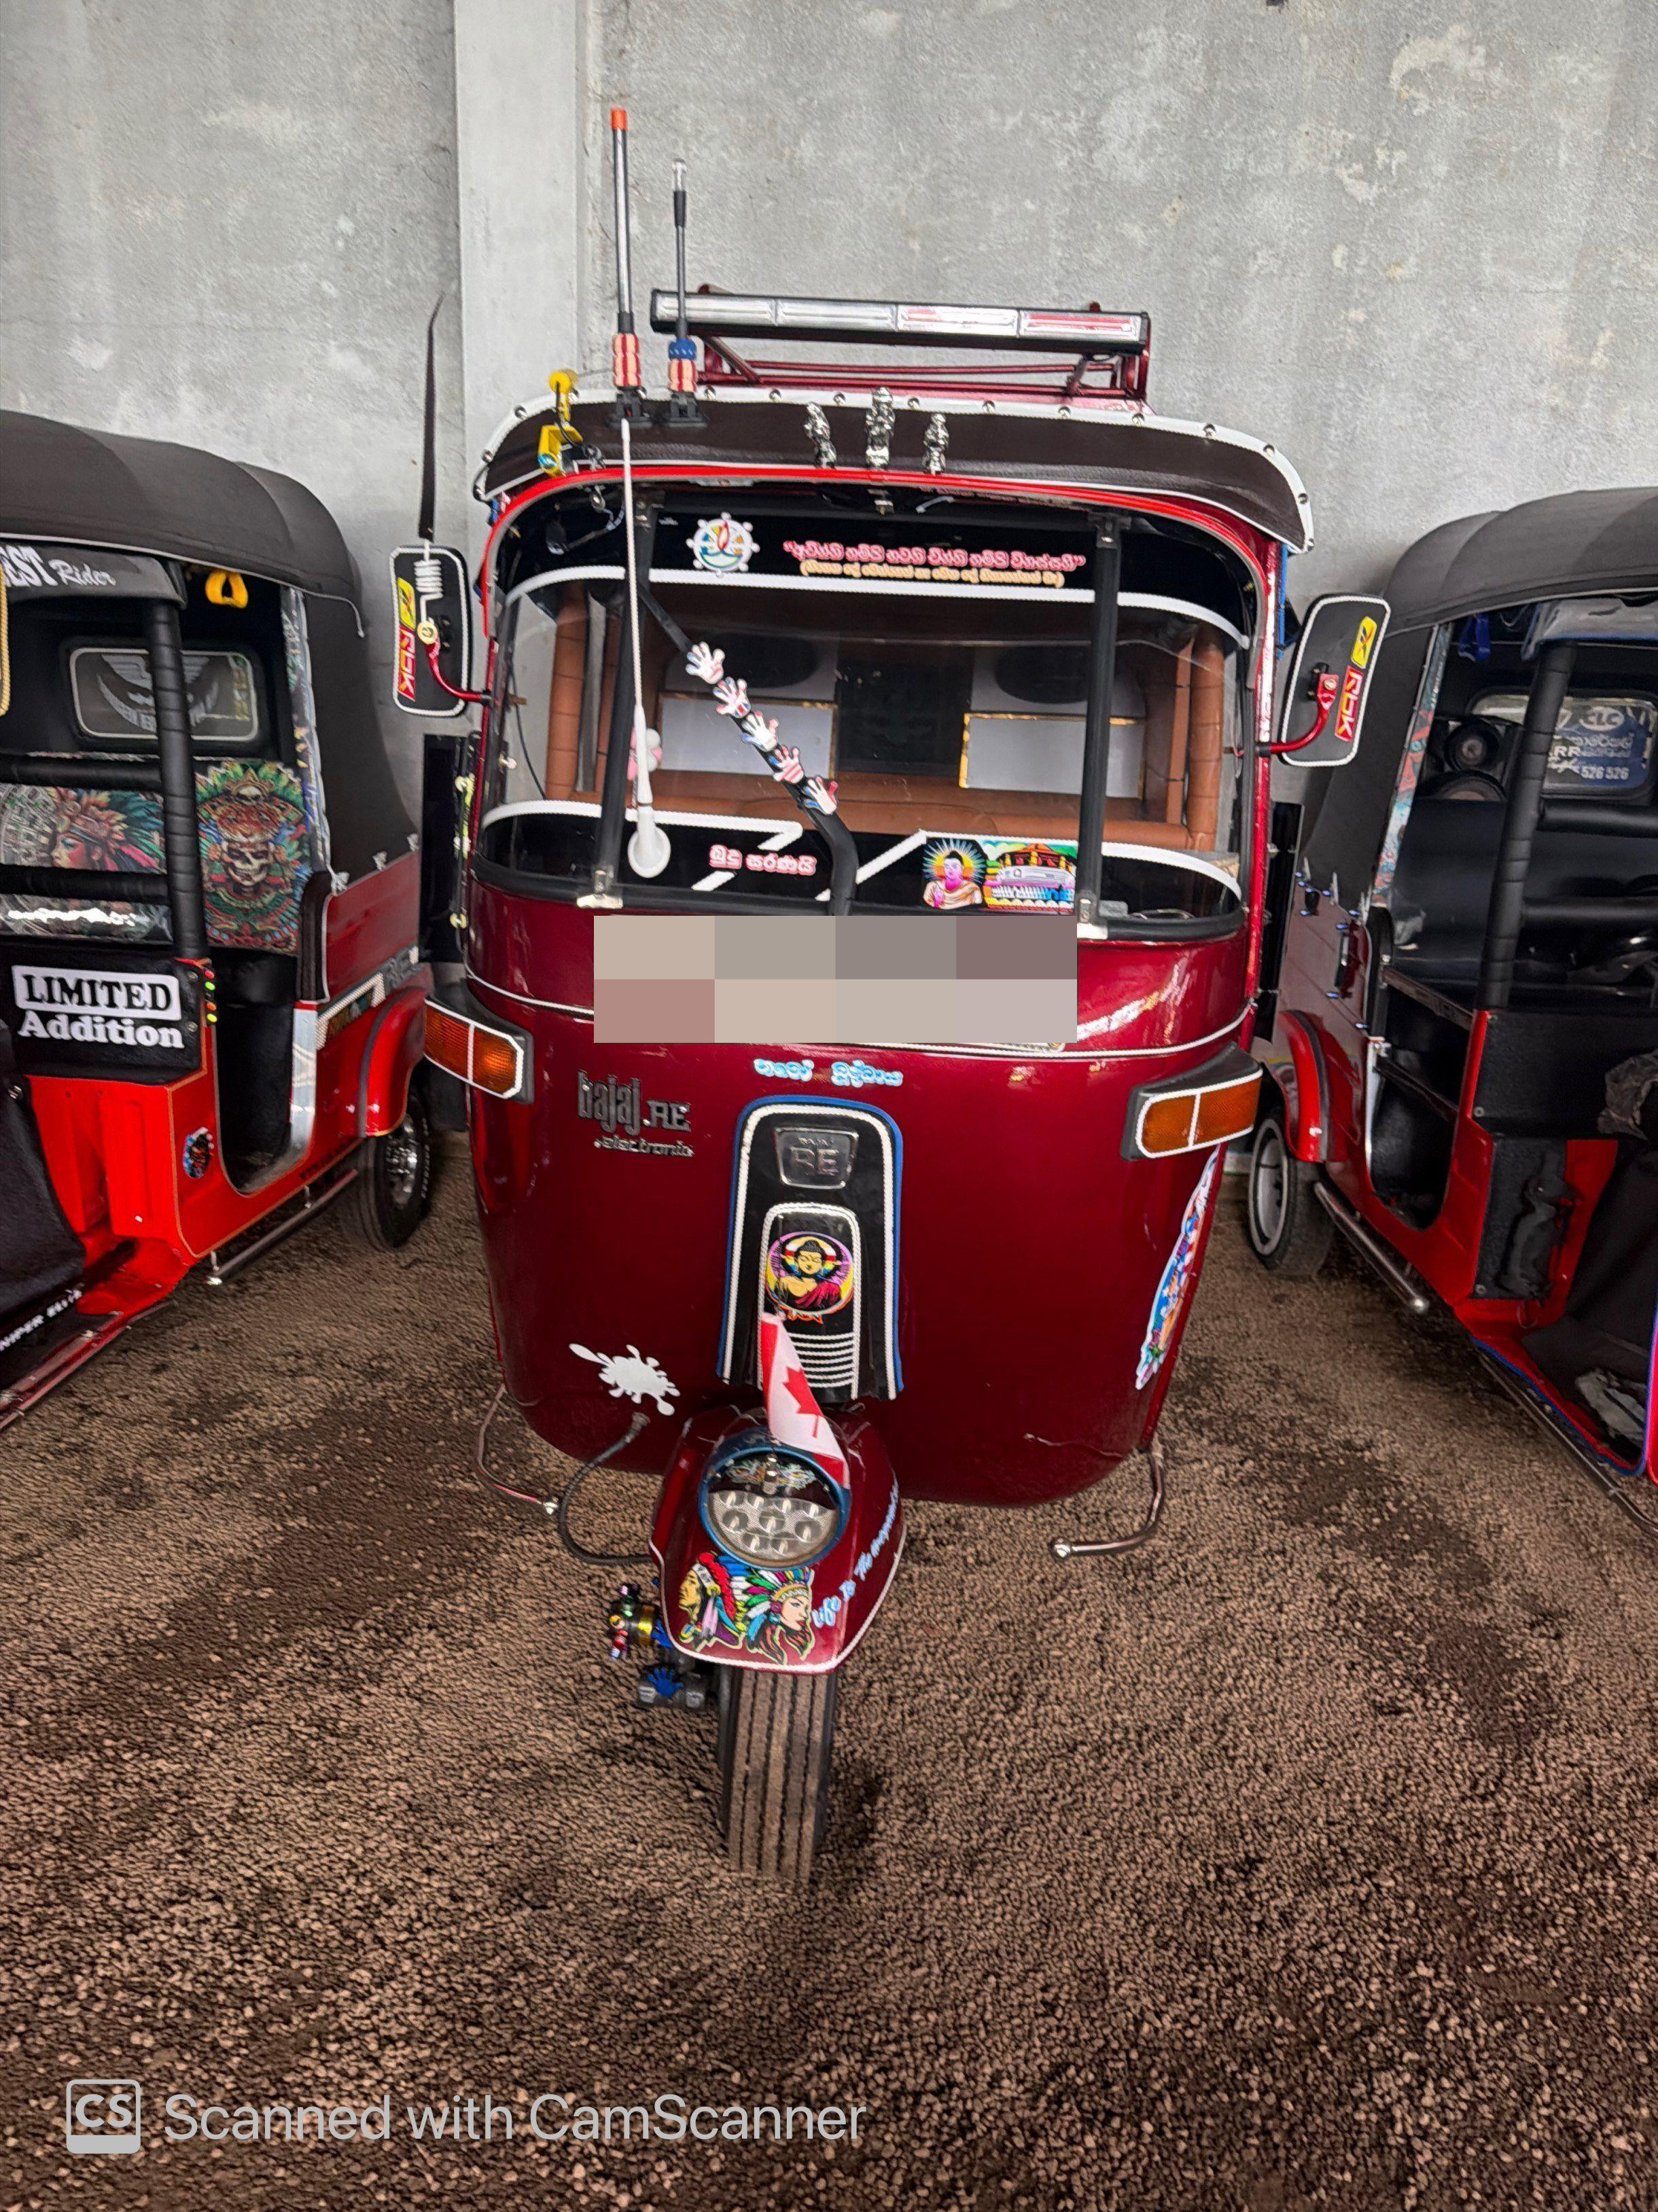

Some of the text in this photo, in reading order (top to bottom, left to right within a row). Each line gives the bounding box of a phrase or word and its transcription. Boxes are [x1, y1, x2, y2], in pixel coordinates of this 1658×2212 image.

[48, 559, 116, 586] Rider
[22, 974, 173, 1010] LIMITED
[17, 1010, 185, 1048] Addition
[578, 1069, 641, 1136] bajaj
[789, 1146, 839, 1176] RE
